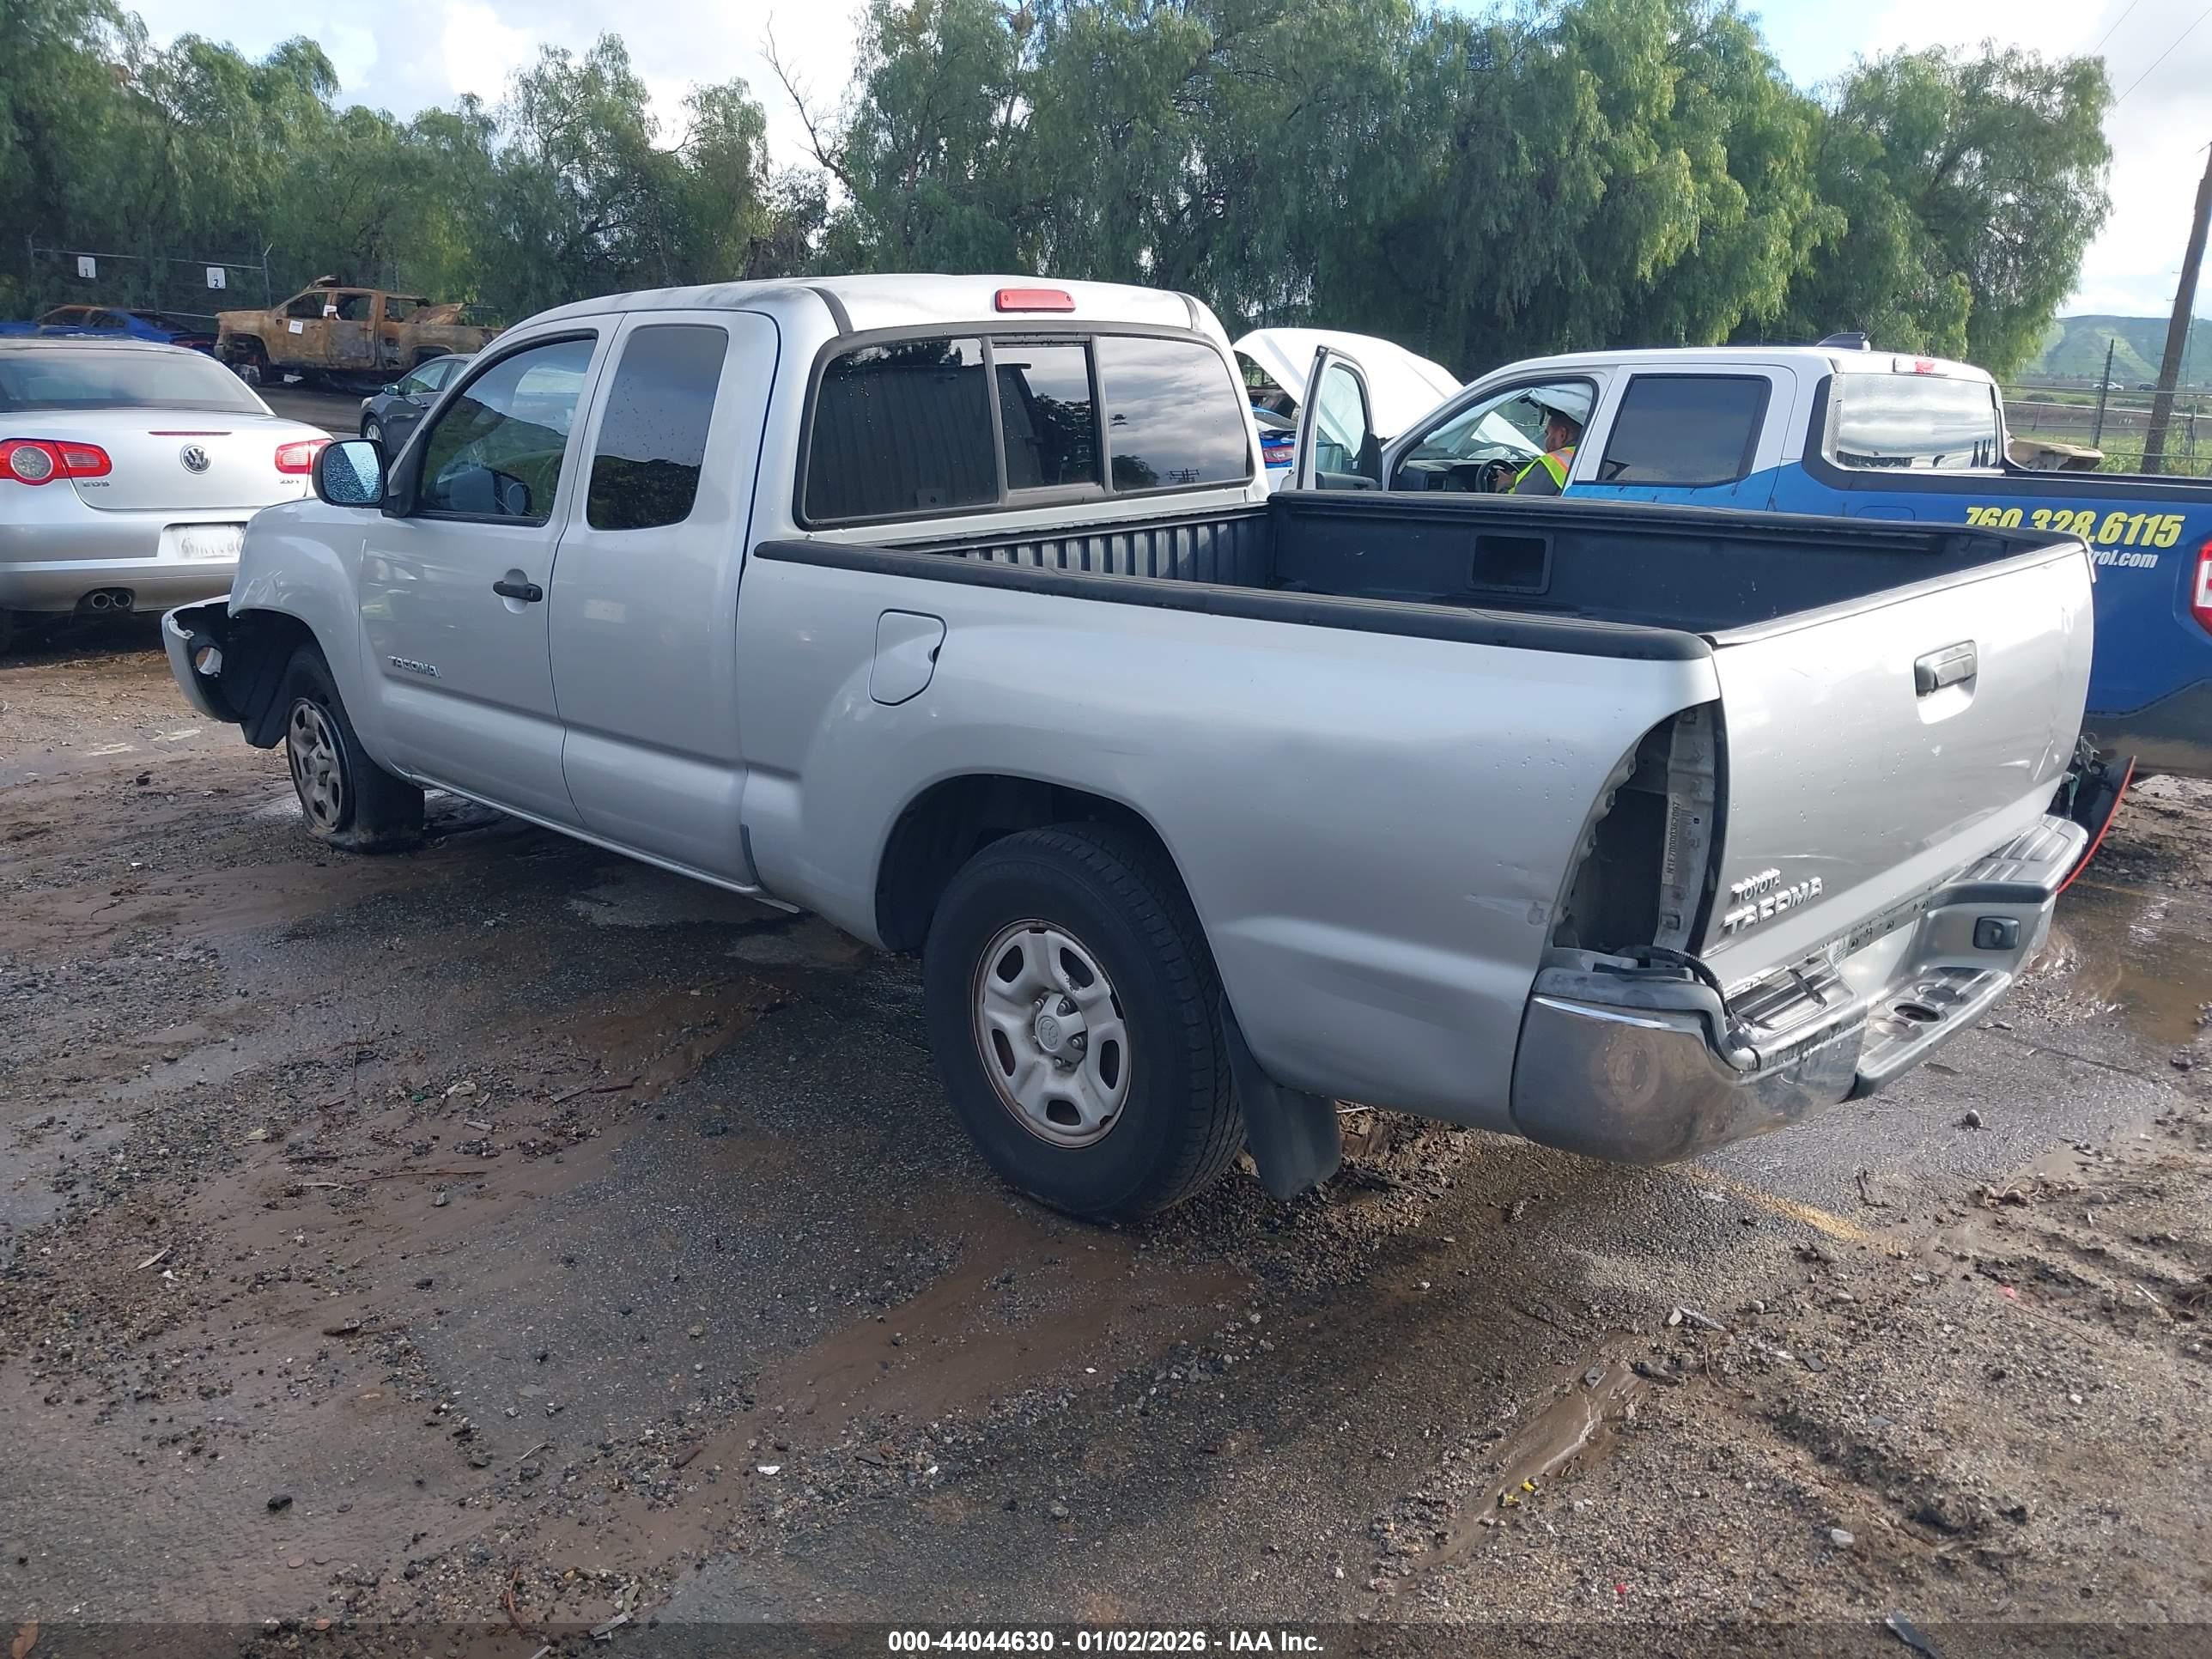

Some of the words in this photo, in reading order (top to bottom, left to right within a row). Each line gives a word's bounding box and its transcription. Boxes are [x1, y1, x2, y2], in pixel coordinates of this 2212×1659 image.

[213, 279, 220, 288] 2
[387, 655, 441, 678] TACOMA
[1730, 867, 1781, 902] TOYOTA
[1723, 877, 1824, 935] TACOMA
